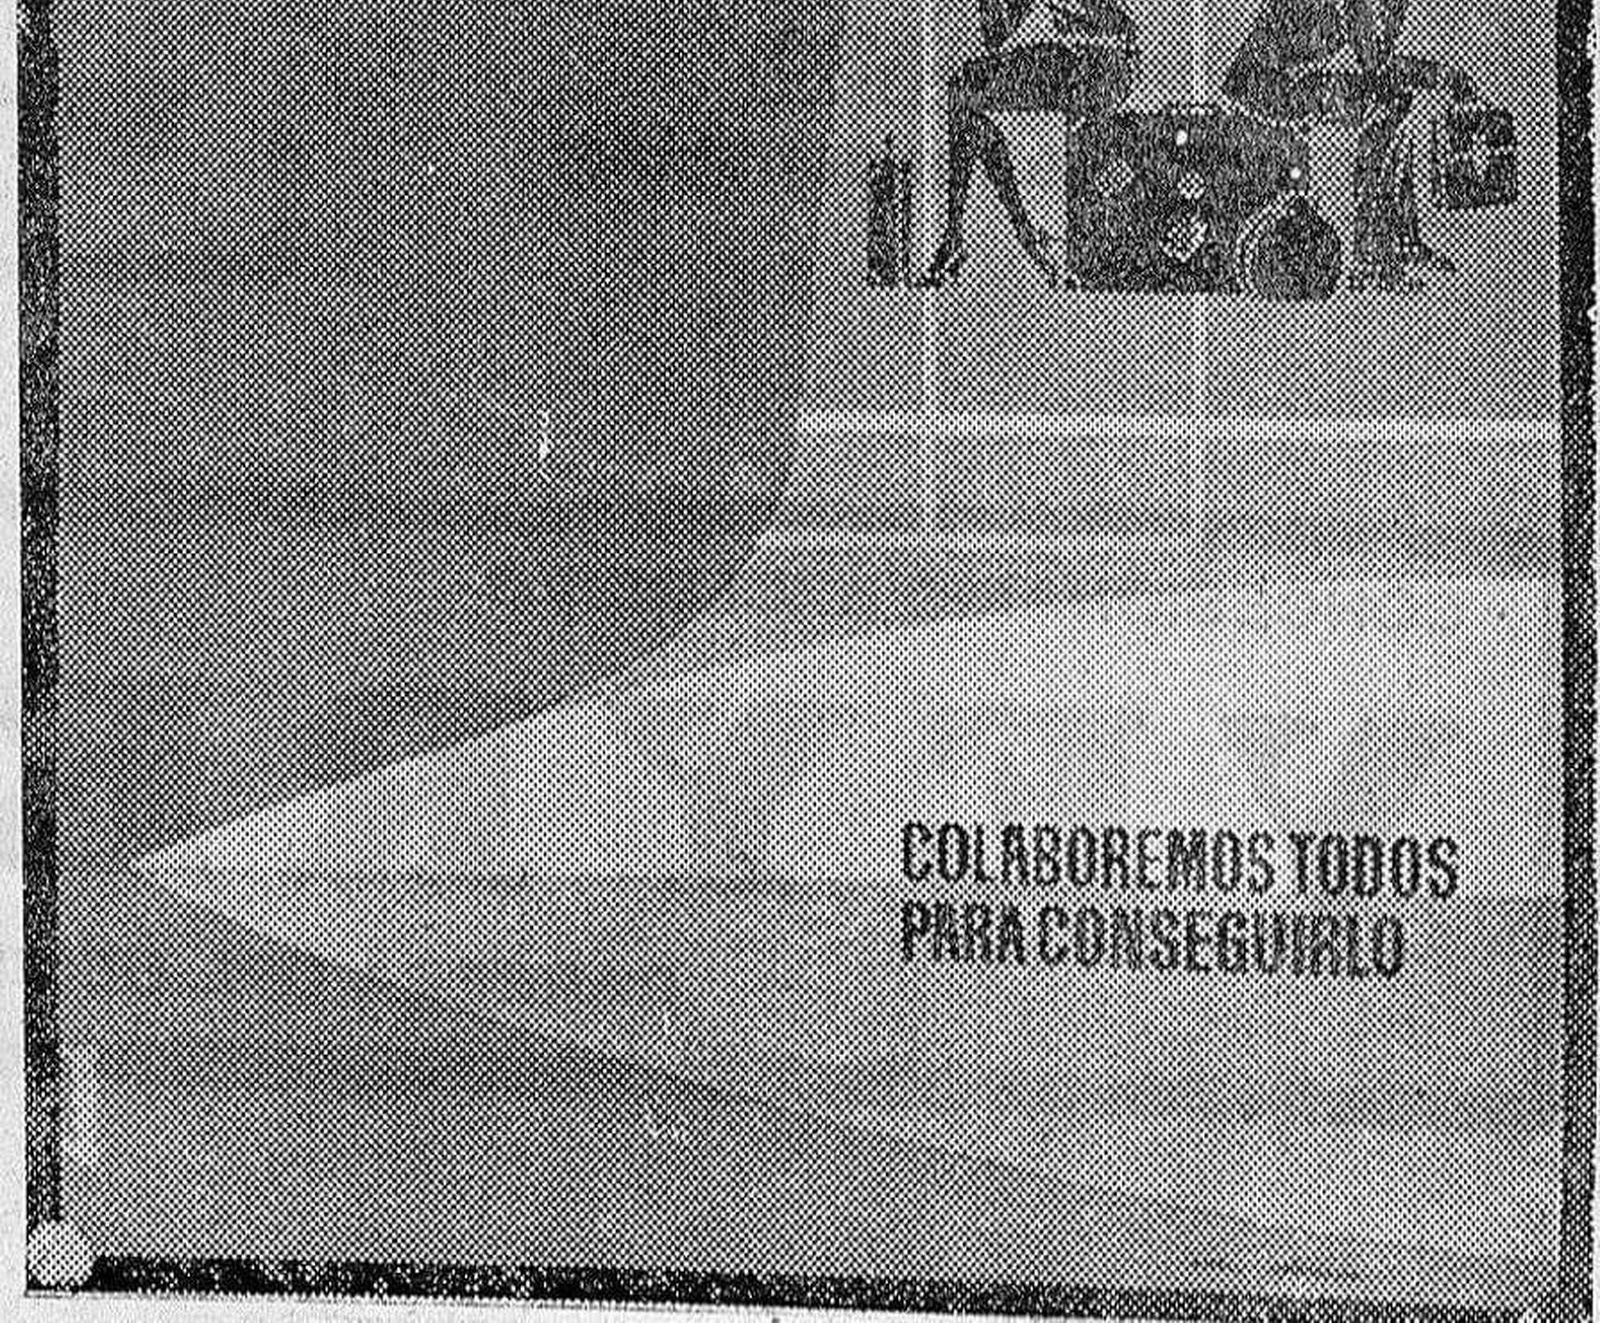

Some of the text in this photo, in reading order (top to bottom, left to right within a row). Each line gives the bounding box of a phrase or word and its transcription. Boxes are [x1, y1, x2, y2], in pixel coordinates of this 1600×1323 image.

[902, 821, 1460, 901] COLABOREMOS TODOS
[901, 898, 1404, 978] PARA CONSEGUIRLO
